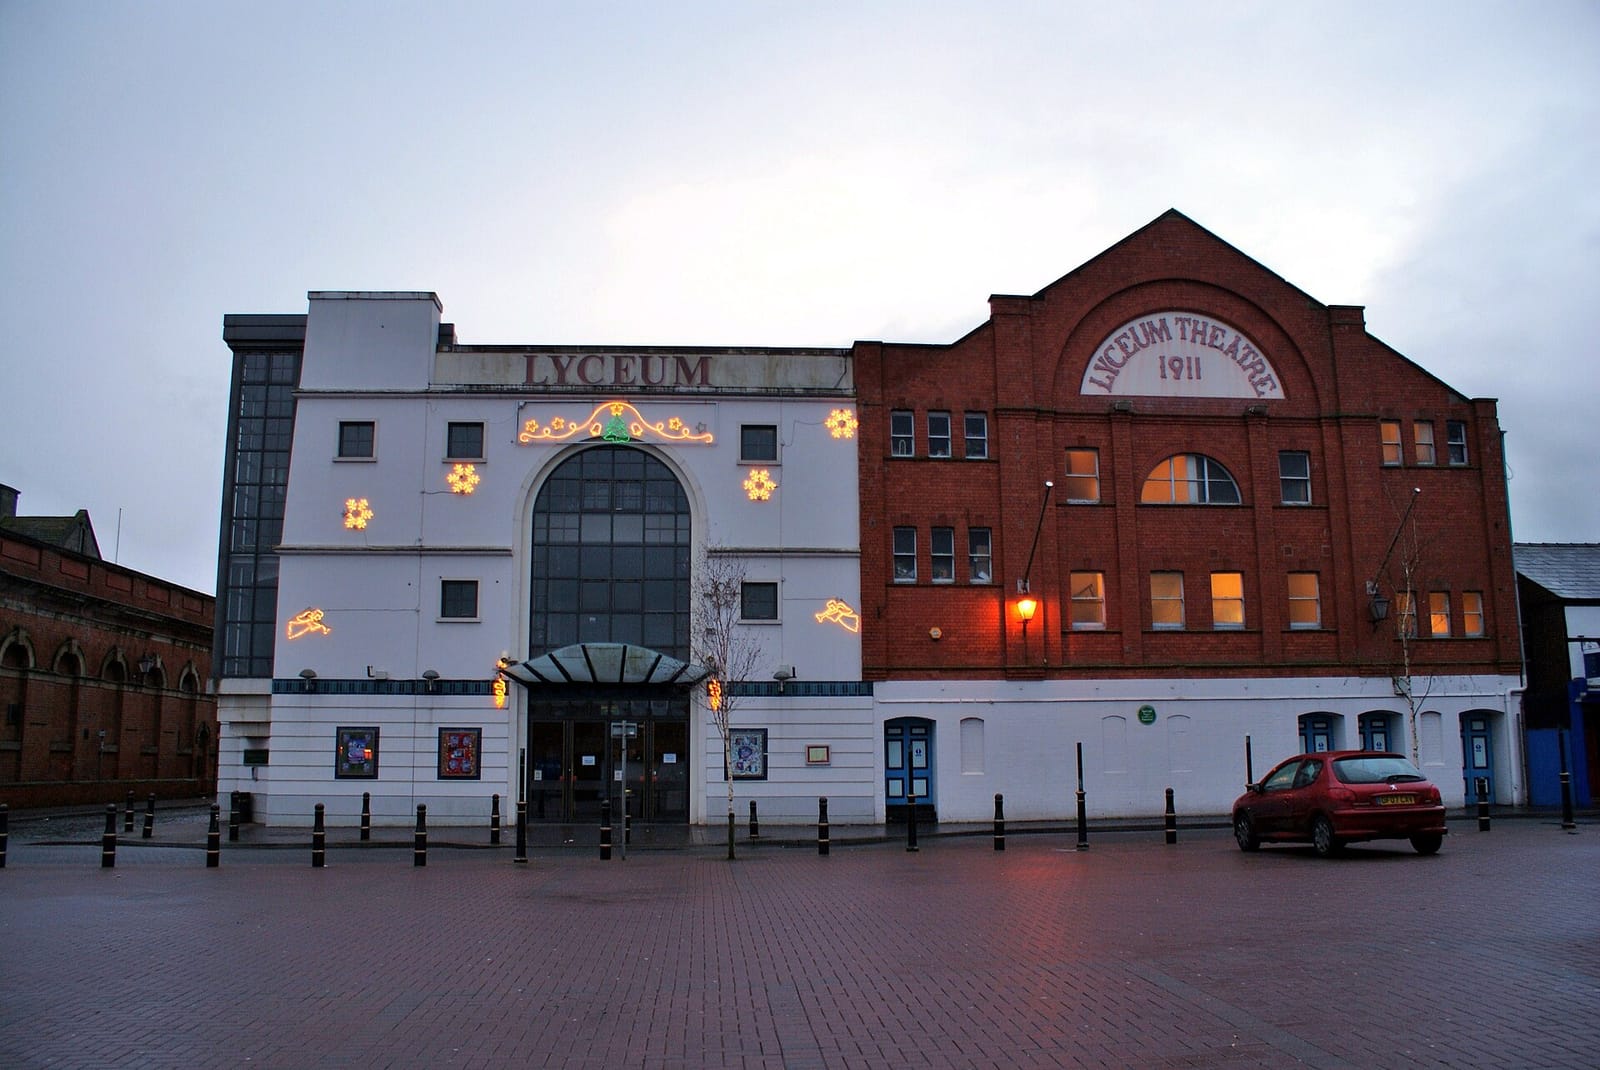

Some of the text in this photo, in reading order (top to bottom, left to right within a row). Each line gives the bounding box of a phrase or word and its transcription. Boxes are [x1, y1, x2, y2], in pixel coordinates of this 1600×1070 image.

[523, 354, 713, 386] LYCEUM
[1089, 317, 1276, 397] LYCEUM THEATRE
[1159, 355, 1202, 380] 1911
